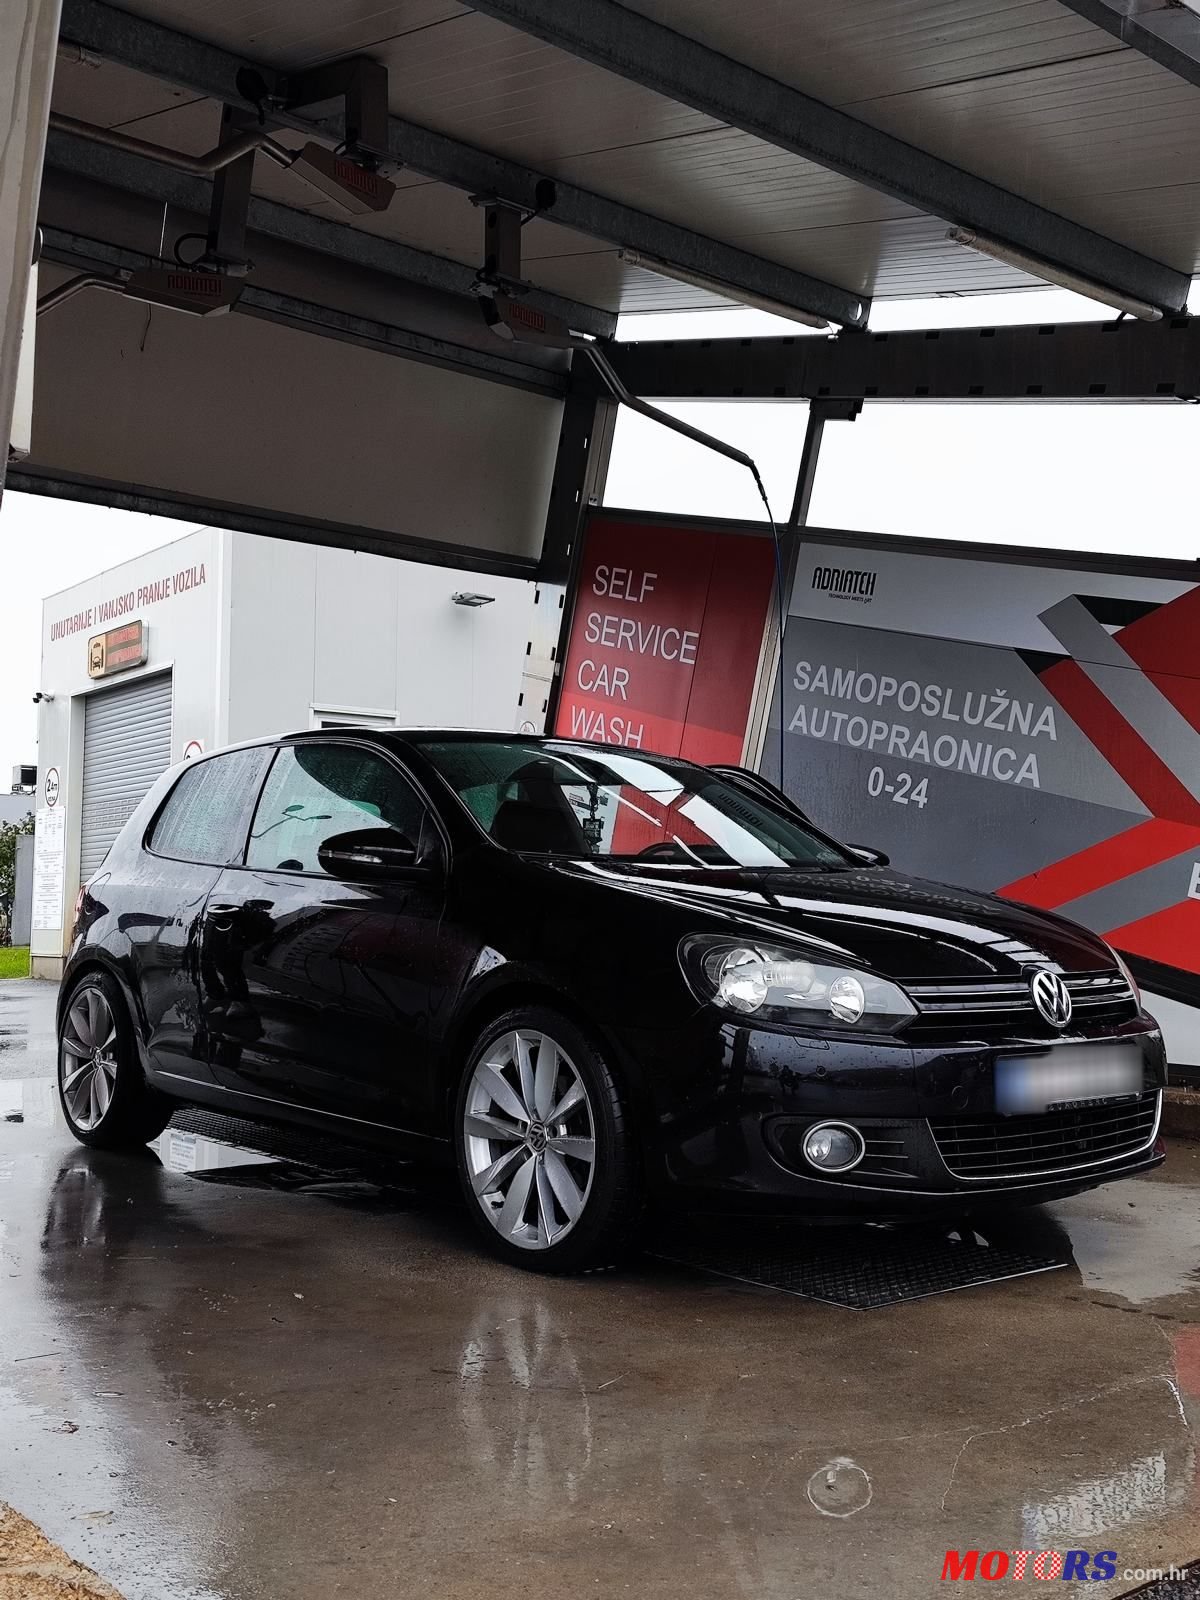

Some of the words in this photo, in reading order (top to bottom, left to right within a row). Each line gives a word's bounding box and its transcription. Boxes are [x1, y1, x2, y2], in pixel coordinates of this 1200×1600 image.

[50, 608, 92, 642] UNUTARNJE
[93, 606, 97, 625] I
[98, 591, 135, 623] VANJSKO
[137, 578, 170, 608] PRANJE
[172, 563, 206, 595] VOZILA
[592, 564, 658, 602] SELF
[585, 612, 700, 665] SERVICE
[577, 659, 630, 701] CAR
[793, 660, 1057, 741] SAMOPOSLUŽNA
[570, 704, 645, 748] WASH
[788, 704, 1041, 788] AUTOPRAONICA
[867, 765, 930, 809] 0-24
